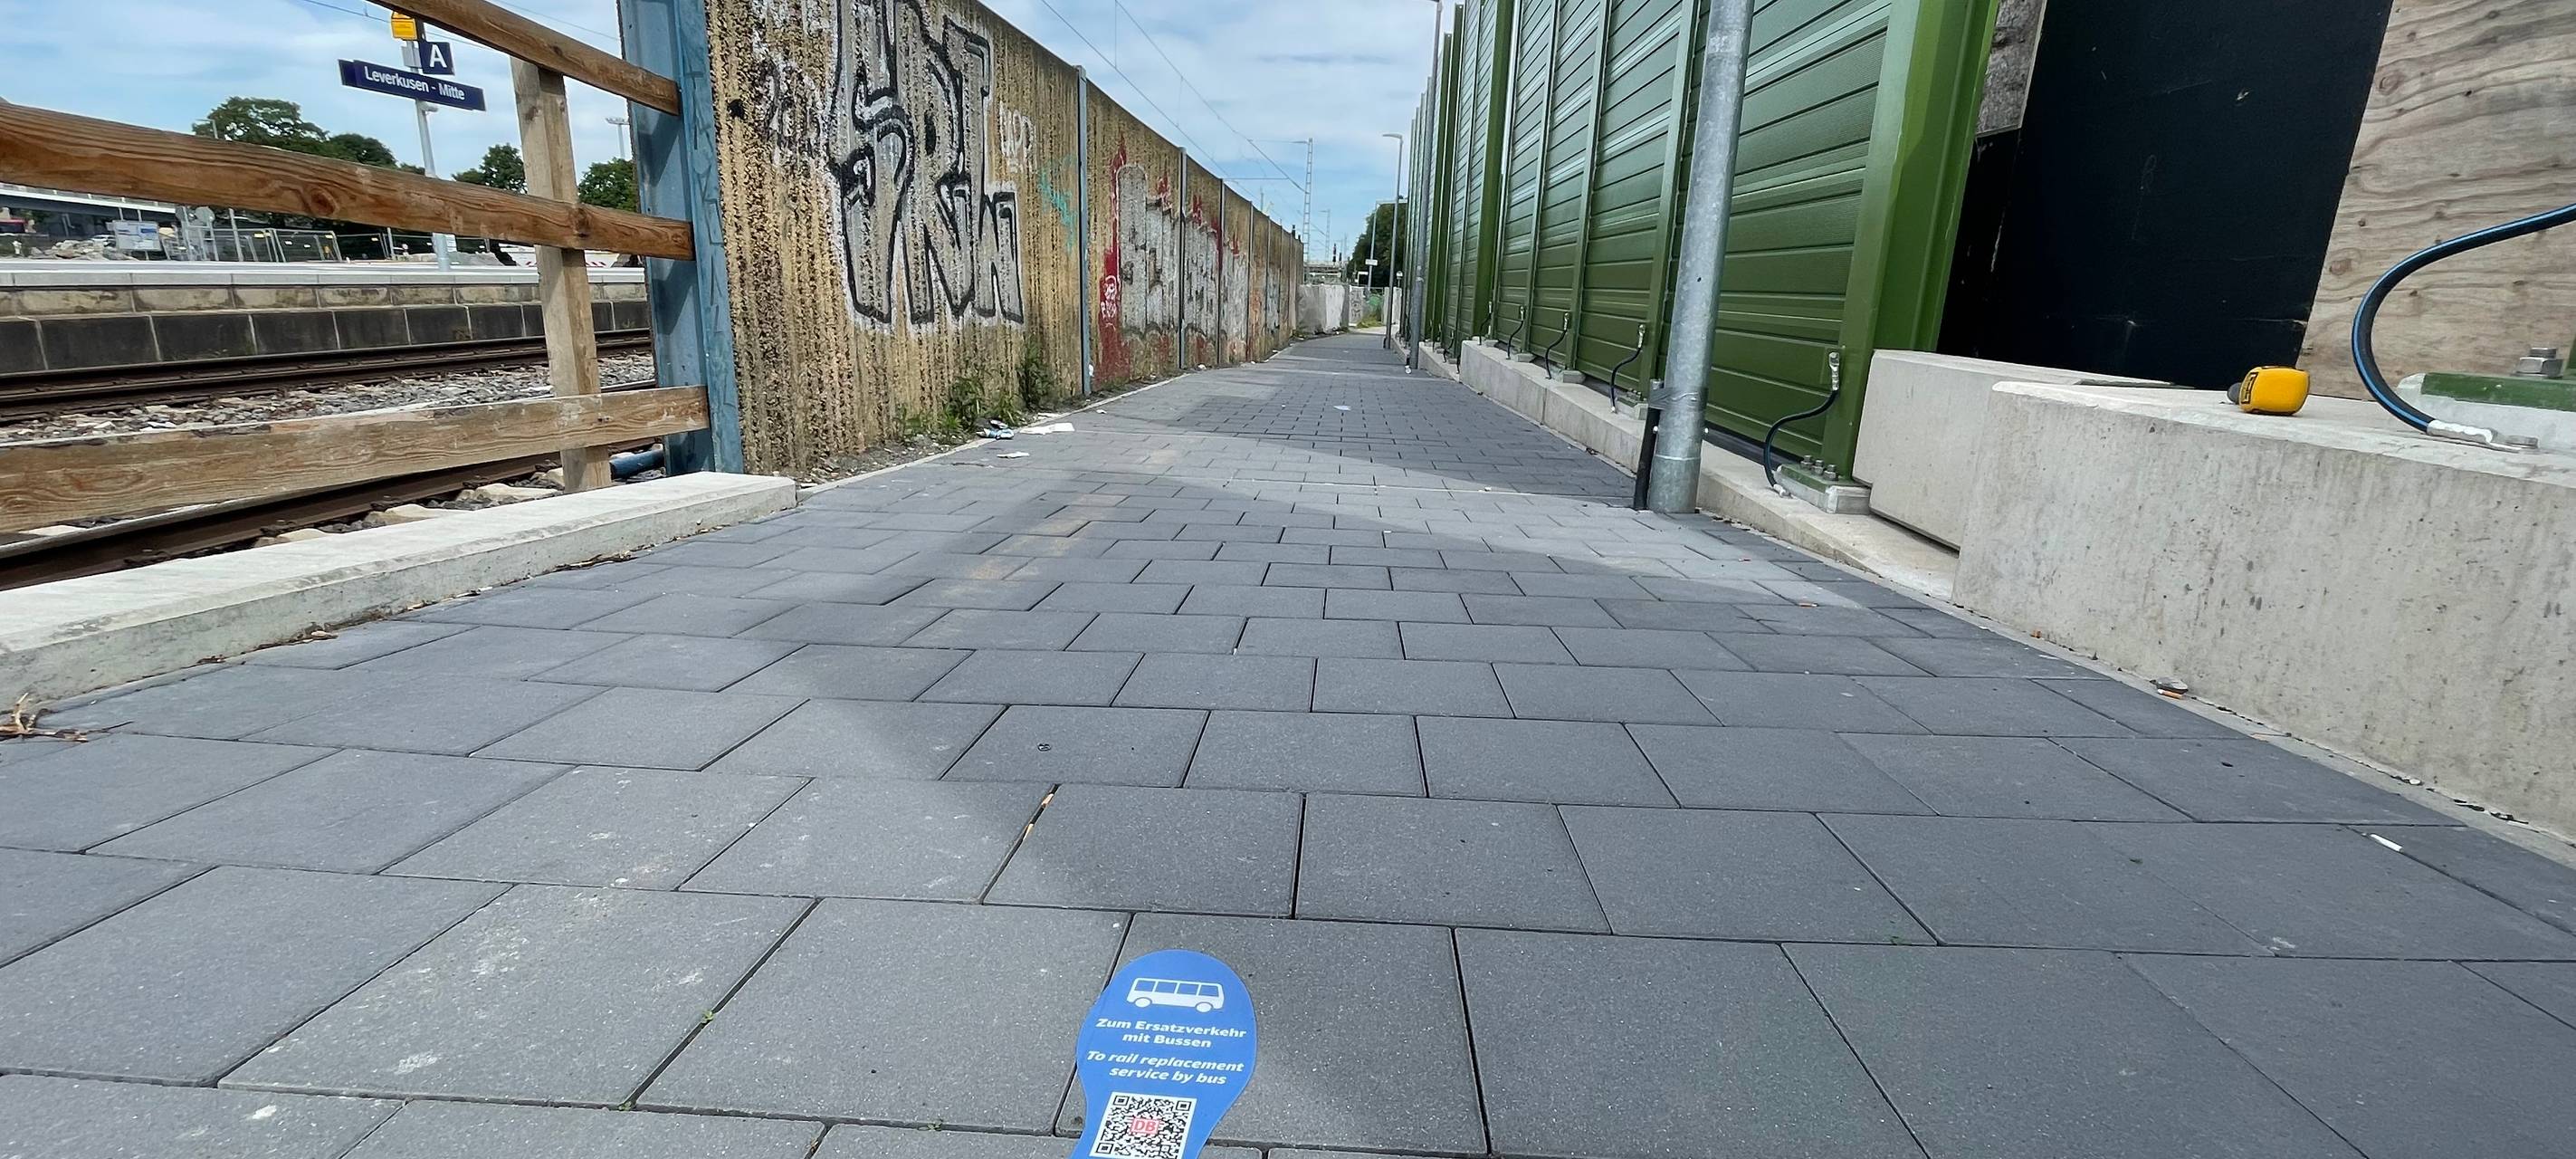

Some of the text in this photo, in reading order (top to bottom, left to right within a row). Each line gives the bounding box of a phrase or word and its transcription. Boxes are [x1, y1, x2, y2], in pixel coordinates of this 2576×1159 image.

[429, 43, 448, 69] A
[364, 65, 429, 92] Leverkusen
[439, 82, 466, 101] Mitte
[1095, 1018, 1247, 1038] Zum Ersatzverkehr
[1121, 1033, 1212, 1048] mit Bussen
[1087, 1050, 1245, 1072] To rail replacement
[1109, 1068, 1227, 1085] service by bus
[1133, 1119, 1157, 1132] DB
